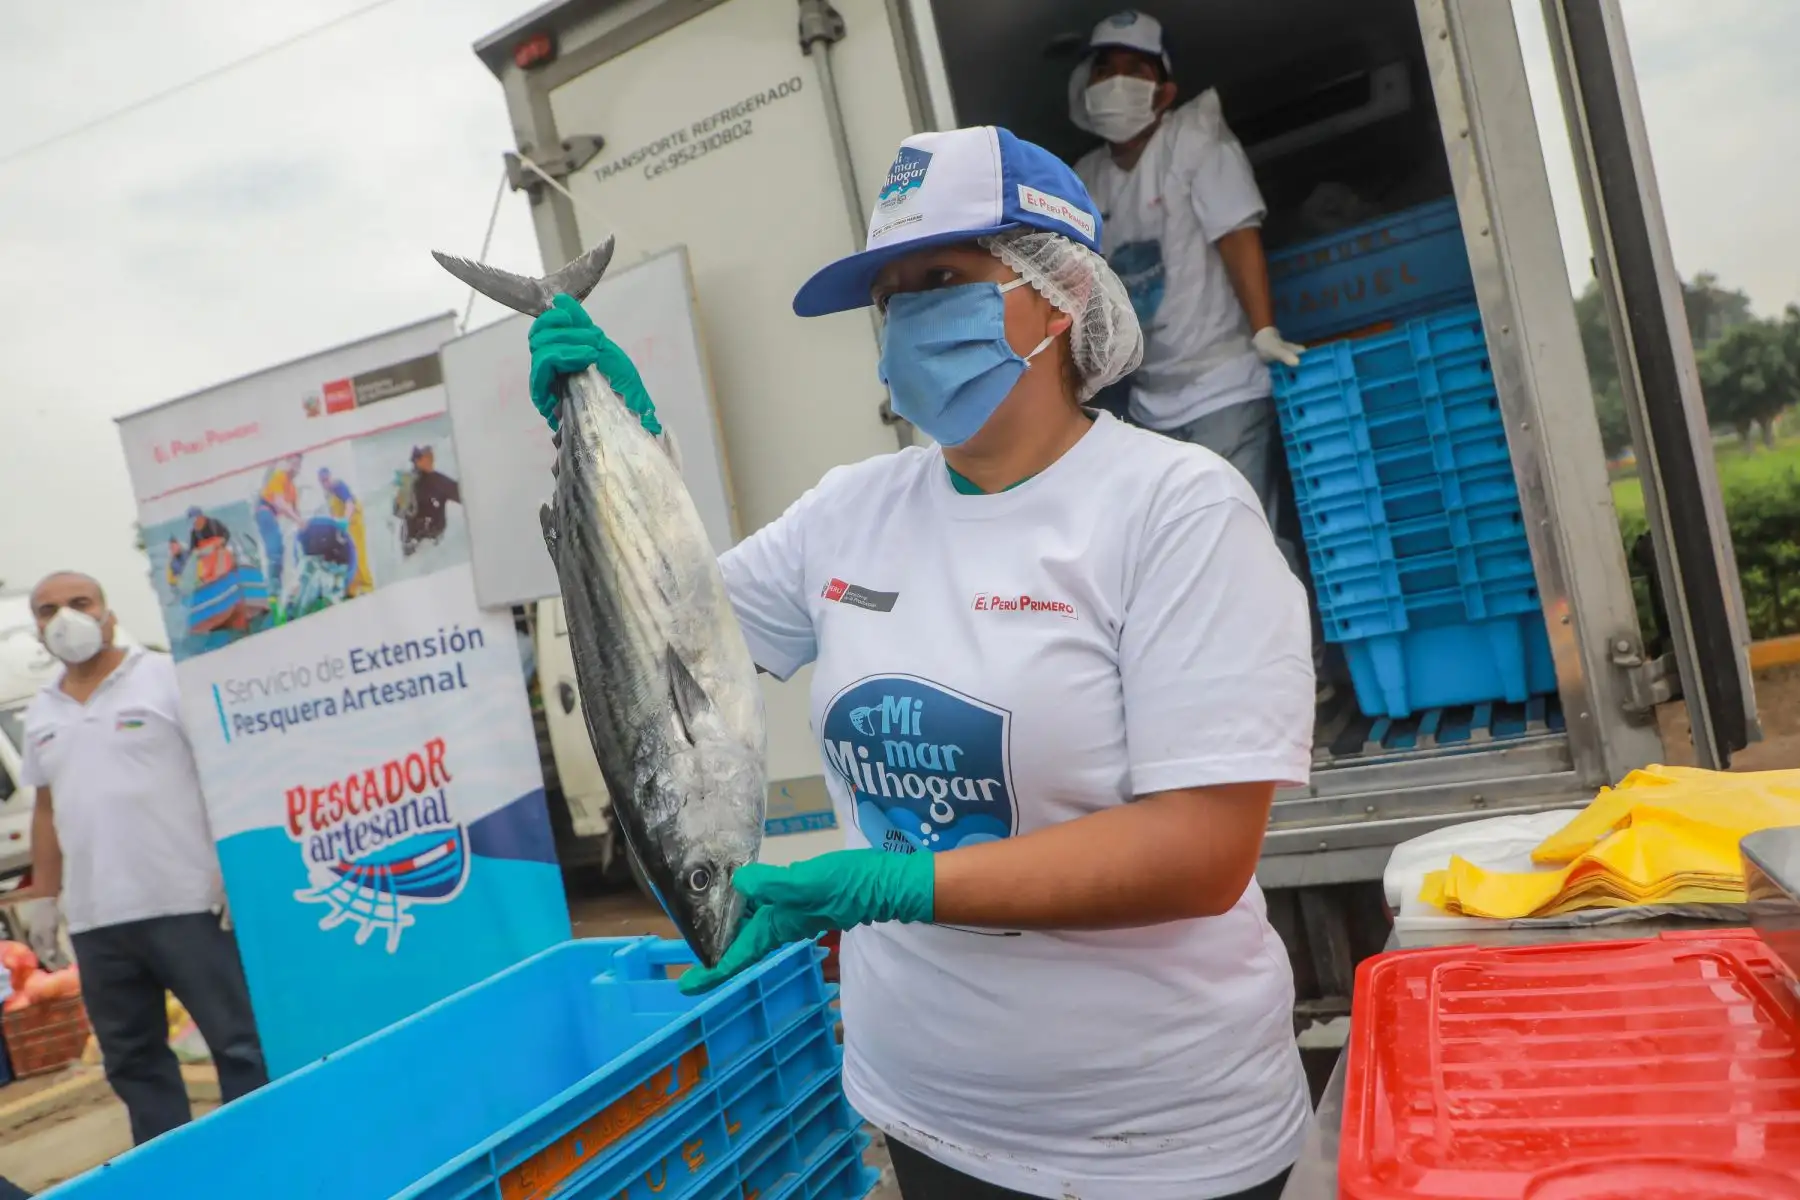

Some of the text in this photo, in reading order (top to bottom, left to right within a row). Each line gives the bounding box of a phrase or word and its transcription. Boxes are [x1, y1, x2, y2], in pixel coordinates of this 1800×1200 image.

[594, 76, 803, 182] TRANSPORTE REFRIGERADO
[894, 161, 919, 173] mar
[974, 596, 988, 611] EL
[1019, 595, 1074, 614] PRIMERO
[224, 624, 485, 705] Servicio de Extensión
[231, 661, 469, 738] Pesquera Artesanal
[881, 695, 924, 736] Mi
[284, 736, 453, 836] PESCADOR
[882, 739, 964, 772] mar
[309, 789, 452, 863] artesanal
